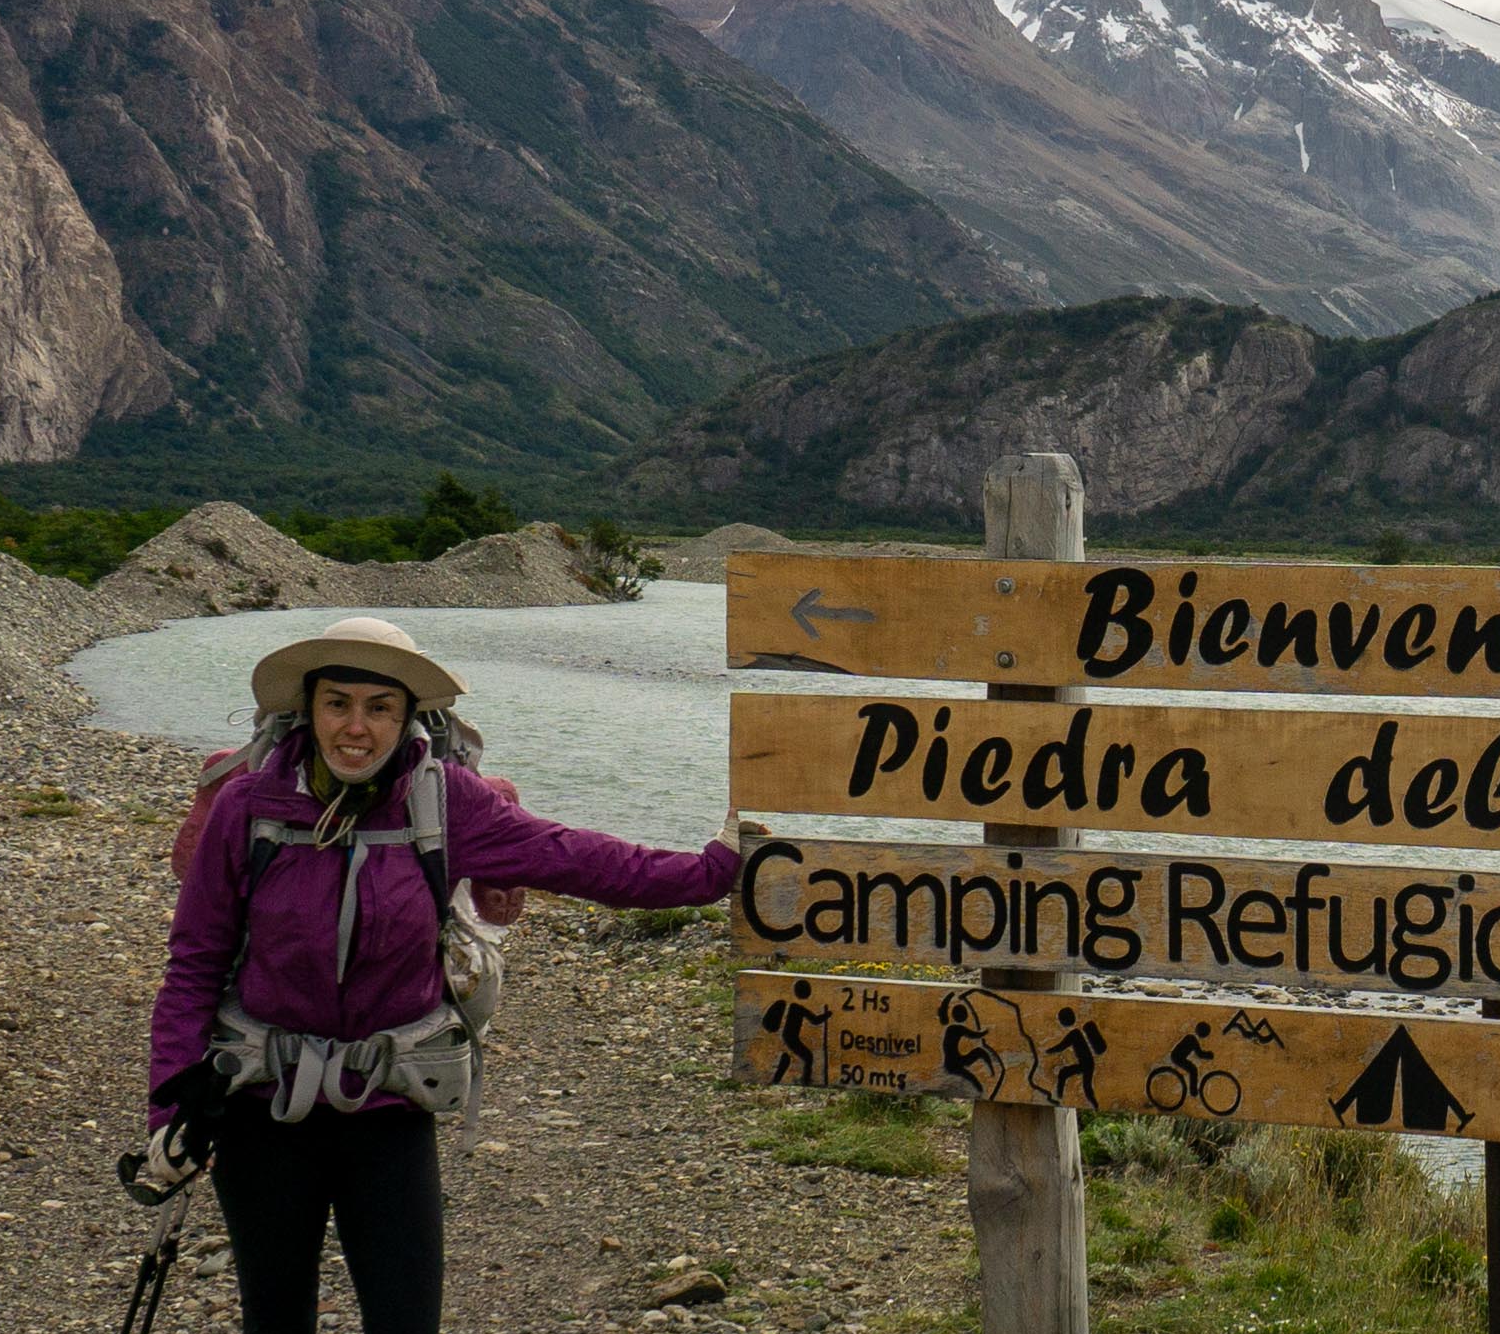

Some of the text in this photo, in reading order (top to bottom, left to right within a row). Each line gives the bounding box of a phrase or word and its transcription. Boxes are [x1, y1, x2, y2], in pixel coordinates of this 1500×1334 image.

[848, 702, 1211, 818] Piedra
[741, 841, 1143, 973] Camping
[842, 987, 891, 1014] 2 Hs
[840, 1029, 921, 1056] Desnivel
[840, 1064, 907, 1091] 50 mts
